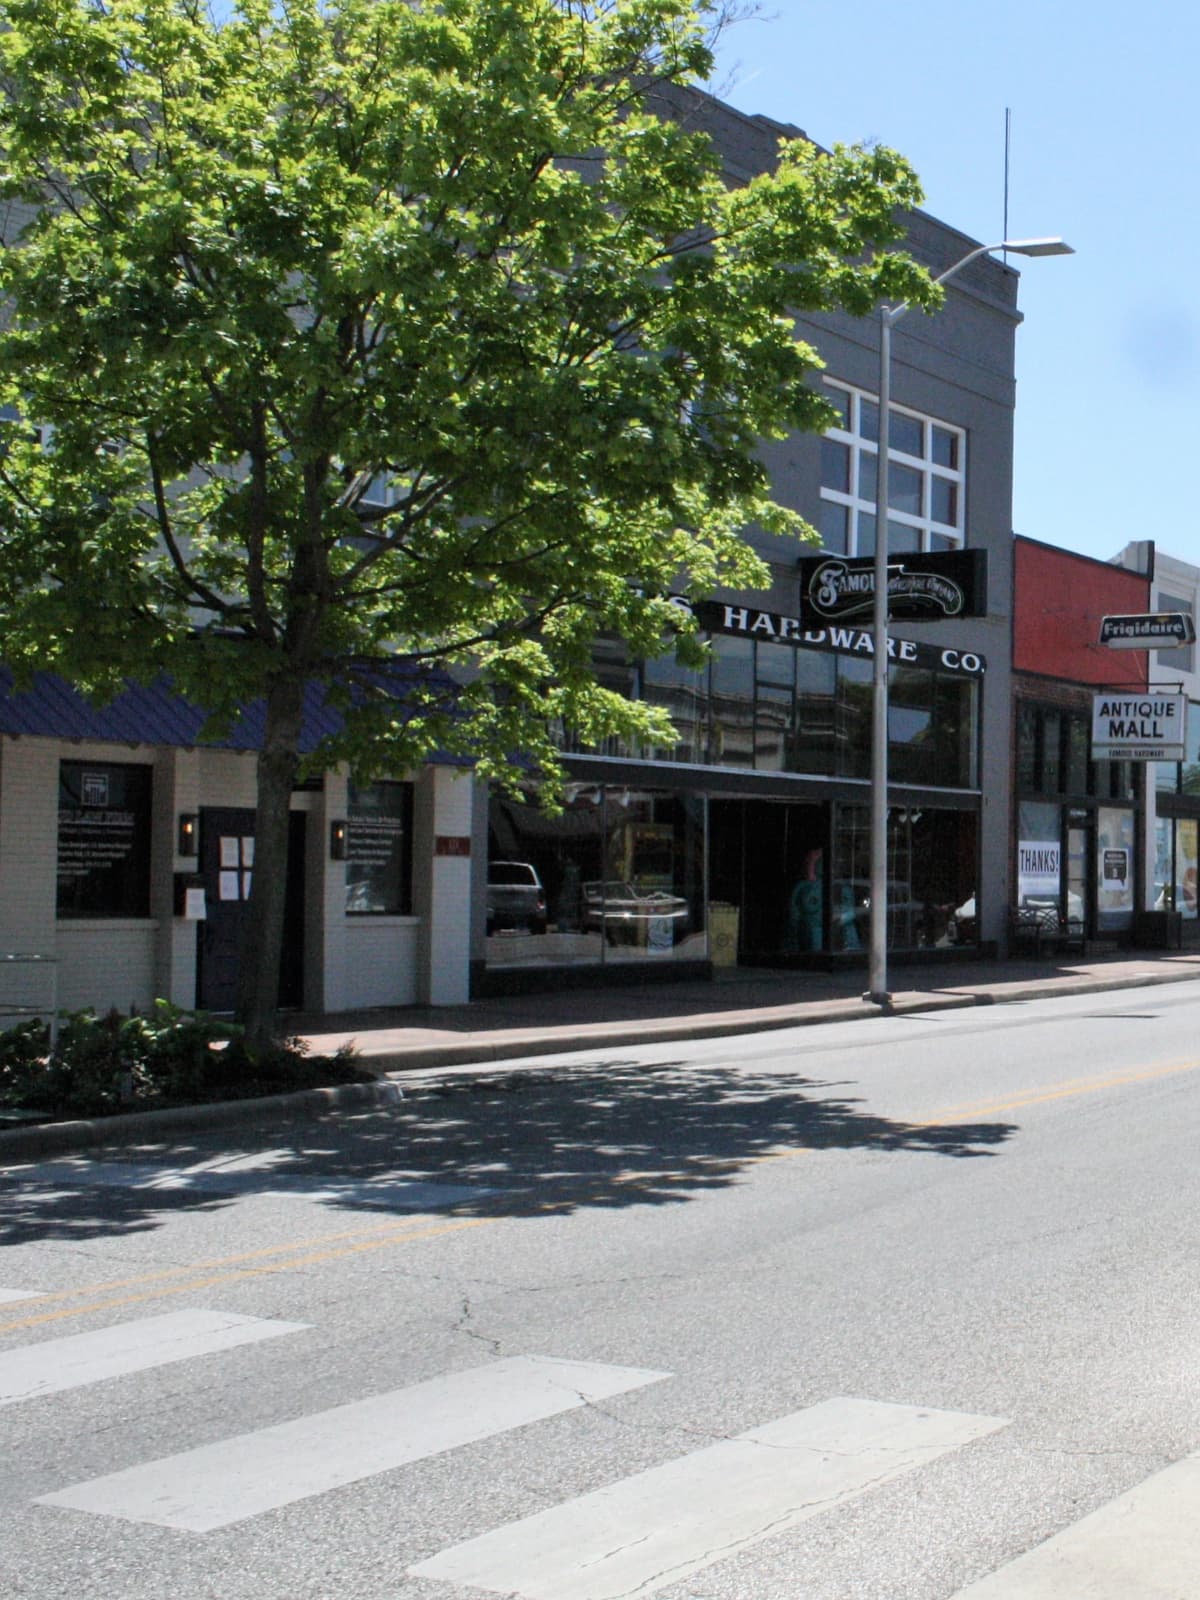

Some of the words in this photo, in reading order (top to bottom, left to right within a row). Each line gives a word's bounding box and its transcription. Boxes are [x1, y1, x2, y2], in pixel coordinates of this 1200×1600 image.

[818, 567, 878, 607] FAMO
[1104, 622, 1183, 637] Frigidaire
[941, 650, 985, 673] CO.
[1099, 702, 1175, 718] ANTIQUE
[1108, 720, 1165, 739] MALL
[1020, 849, 1059, 872] THANKS!
